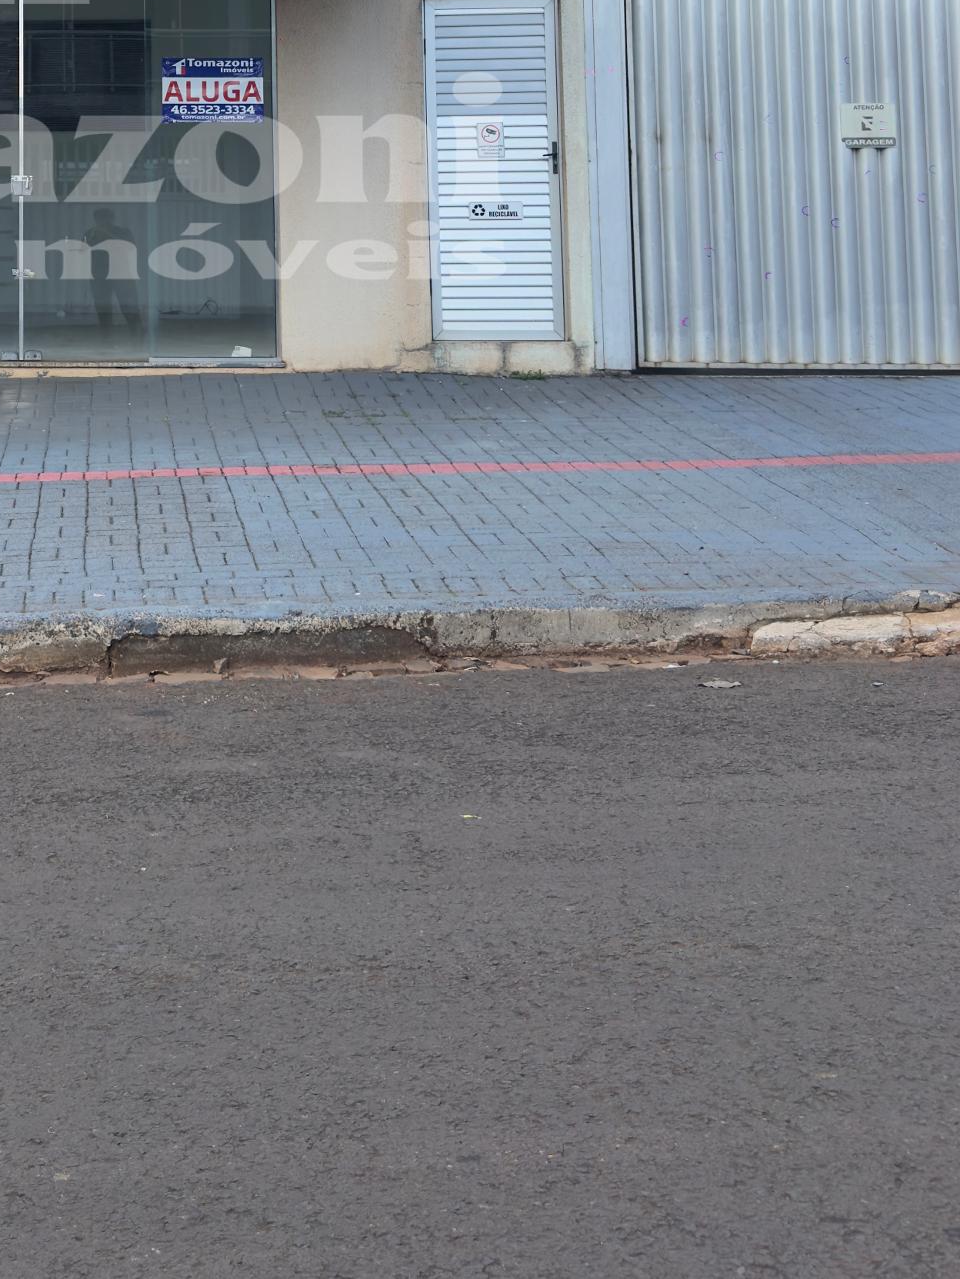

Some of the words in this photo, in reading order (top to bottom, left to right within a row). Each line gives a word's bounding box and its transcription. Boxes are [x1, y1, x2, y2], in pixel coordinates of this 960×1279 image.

[187, 58, 254, 67] Tomazoni
[164, 80, 262, 102] ALUGA
[170, 105, 256, 115] 46.3523-3334
